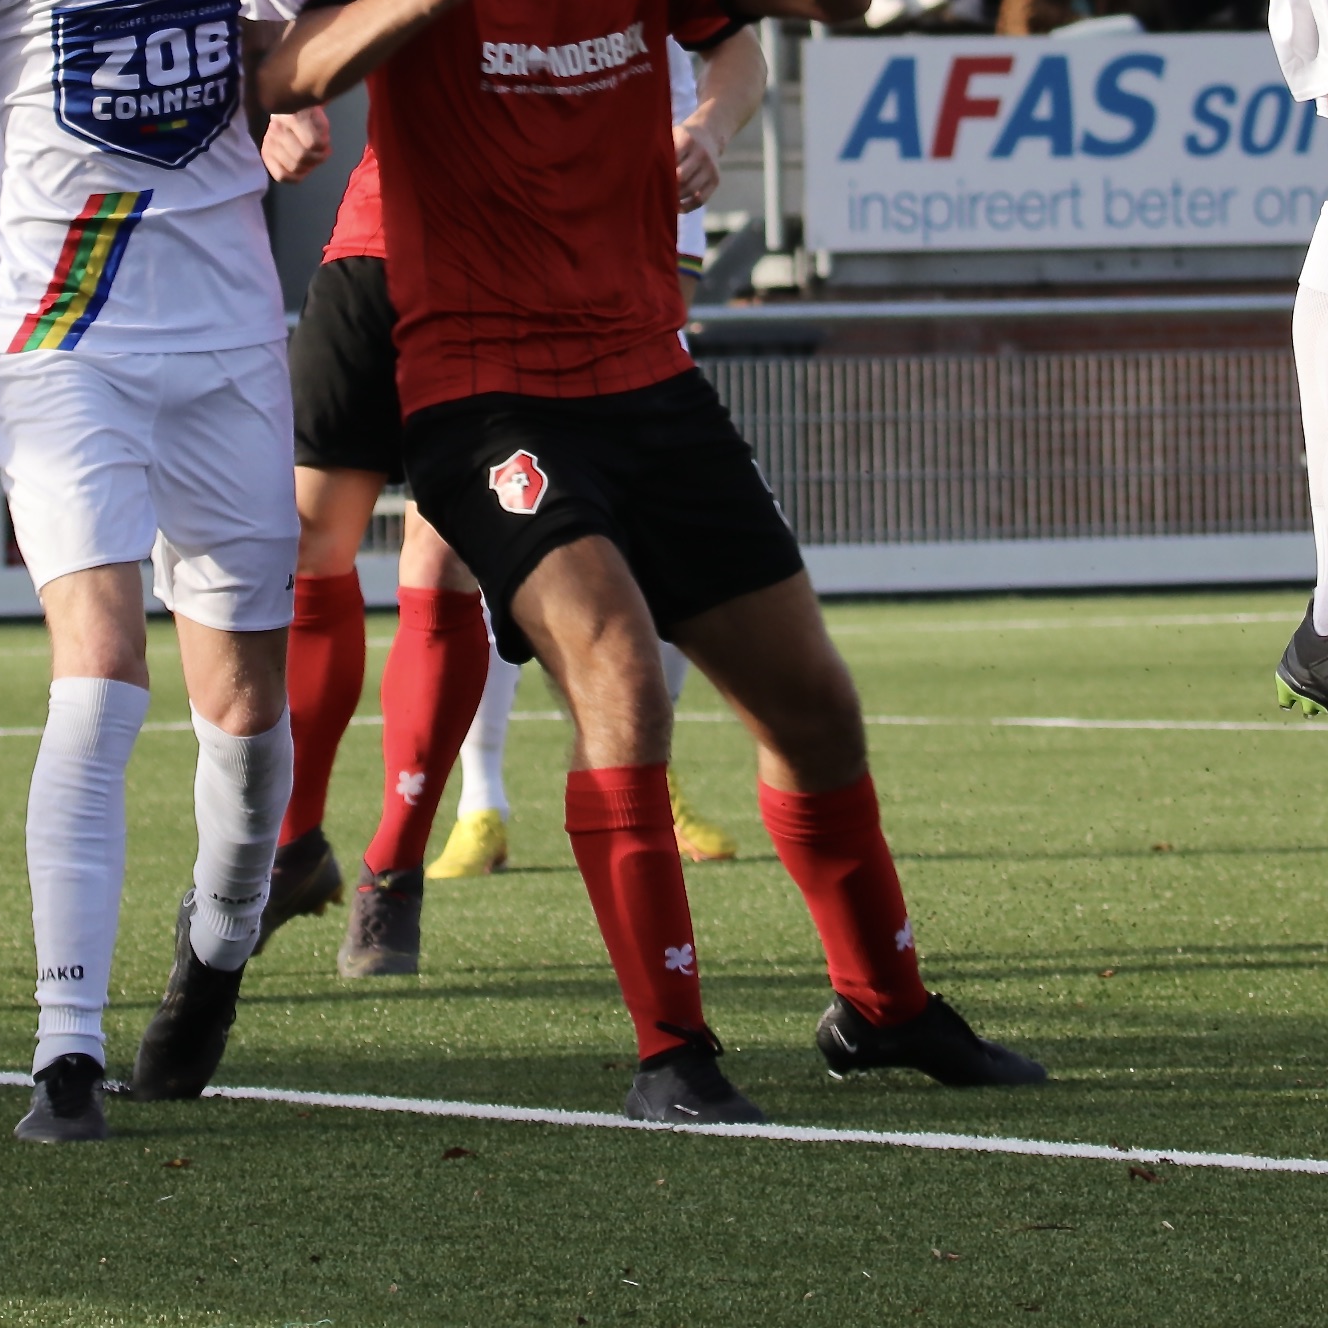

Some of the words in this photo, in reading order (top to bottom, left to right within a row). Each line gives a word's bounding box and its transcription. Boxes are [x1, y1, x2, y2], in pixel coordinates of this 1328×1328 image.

[150, 9, 195, 23] SPONSOR
[91, 21, 231, 90] ZOB
[92, 77, 228, 120] CONNECT
[838, 52, 1165, 160] AFAS
[847, 177, 1084, 244] inspireert
[1102, 177, 1237, 230] beter
[39, 965, 84, 983] JAKO
